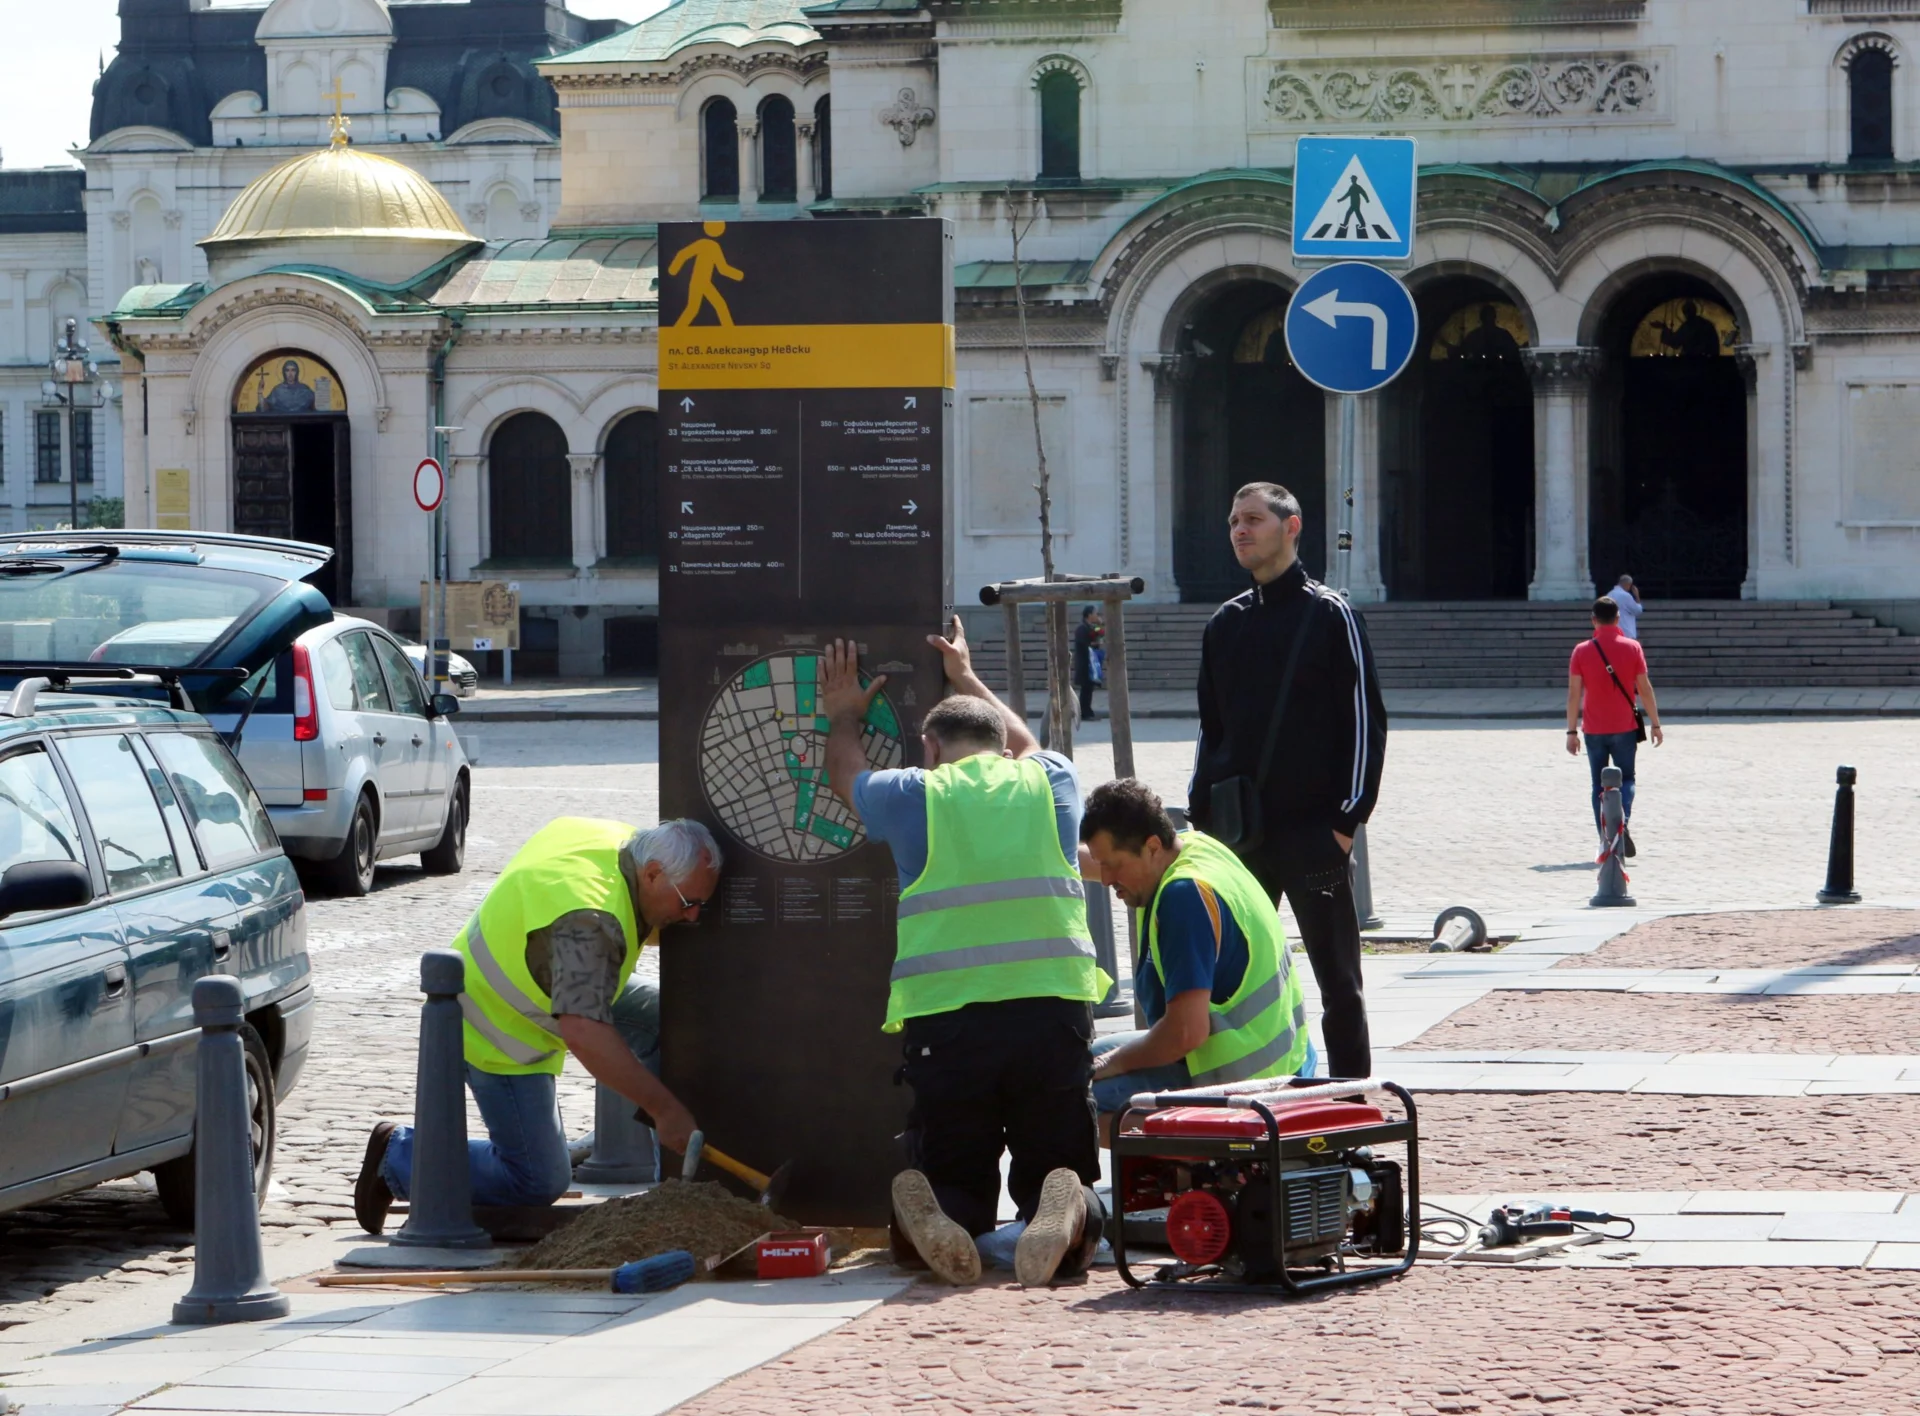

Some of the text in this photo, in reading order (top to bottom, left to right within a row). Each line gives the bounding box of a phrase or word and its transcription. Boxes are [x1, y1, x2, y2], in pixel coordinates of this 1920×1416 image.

[687, 346, 703, 355] Св.
[707, 346, 768, 356] Александър
[772, 345, 810, 354] Невски
[762, 1247, 810, 1257] HILTI
